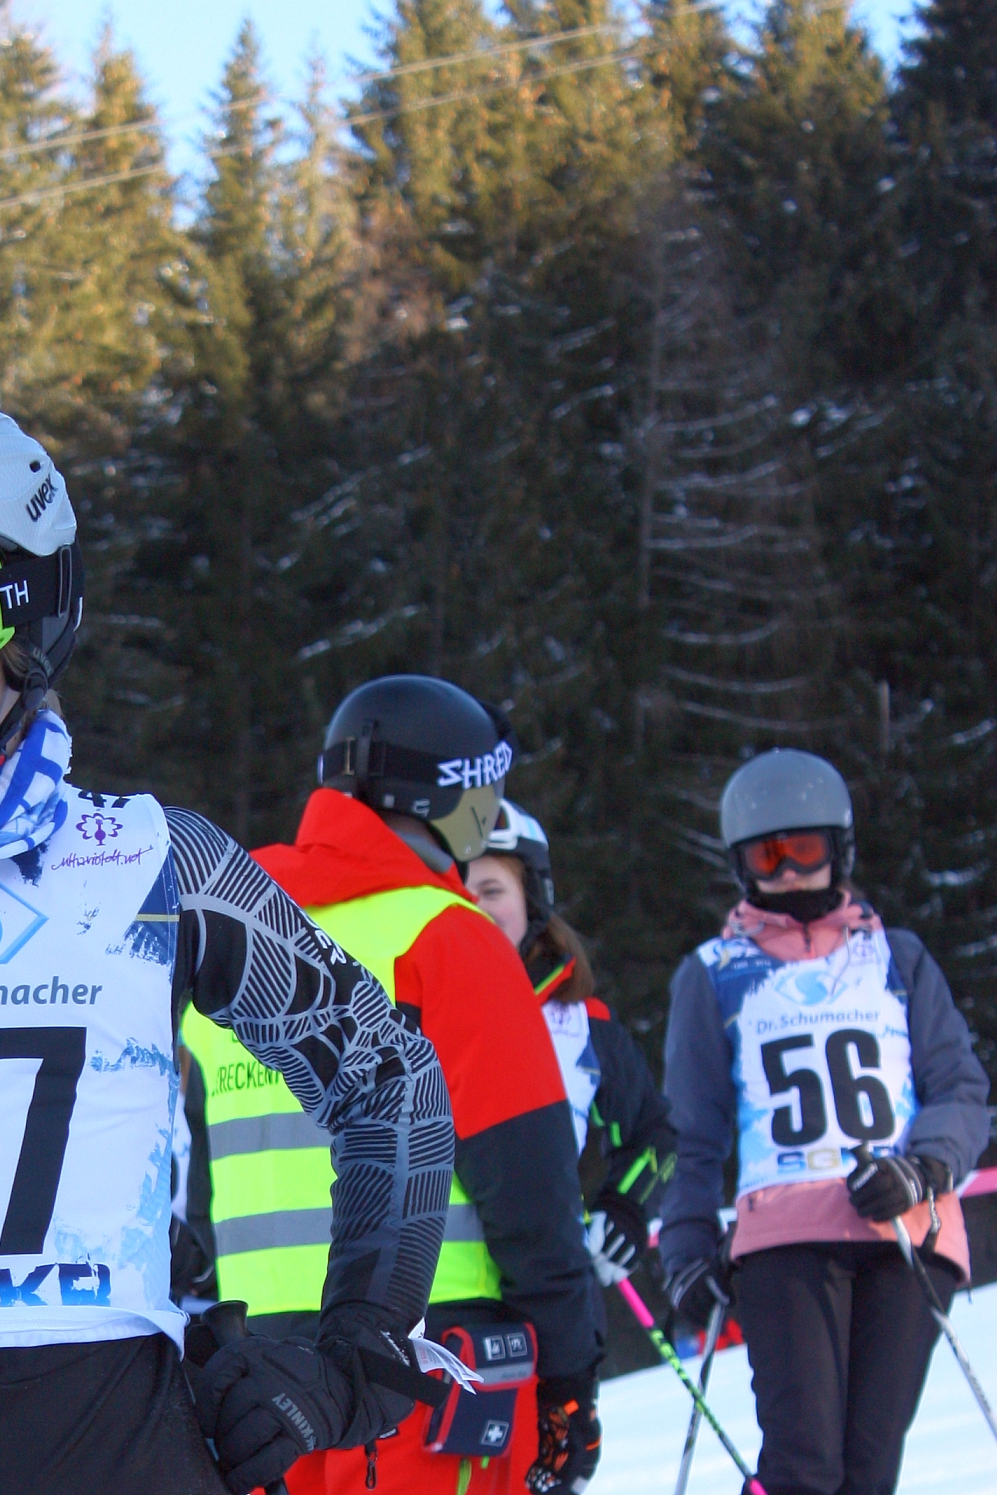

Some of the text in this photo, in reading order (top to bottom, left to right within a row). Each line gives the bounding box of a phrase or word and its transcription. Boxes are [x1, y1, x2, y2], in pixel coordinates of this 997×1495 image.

[25, 472, 58, 522] uvex
[436, 739, 513, 790] SHRED
[757, 1007, 880, 1034] Dr. Schumacher
[760, 1027, 896, 1148] 56
